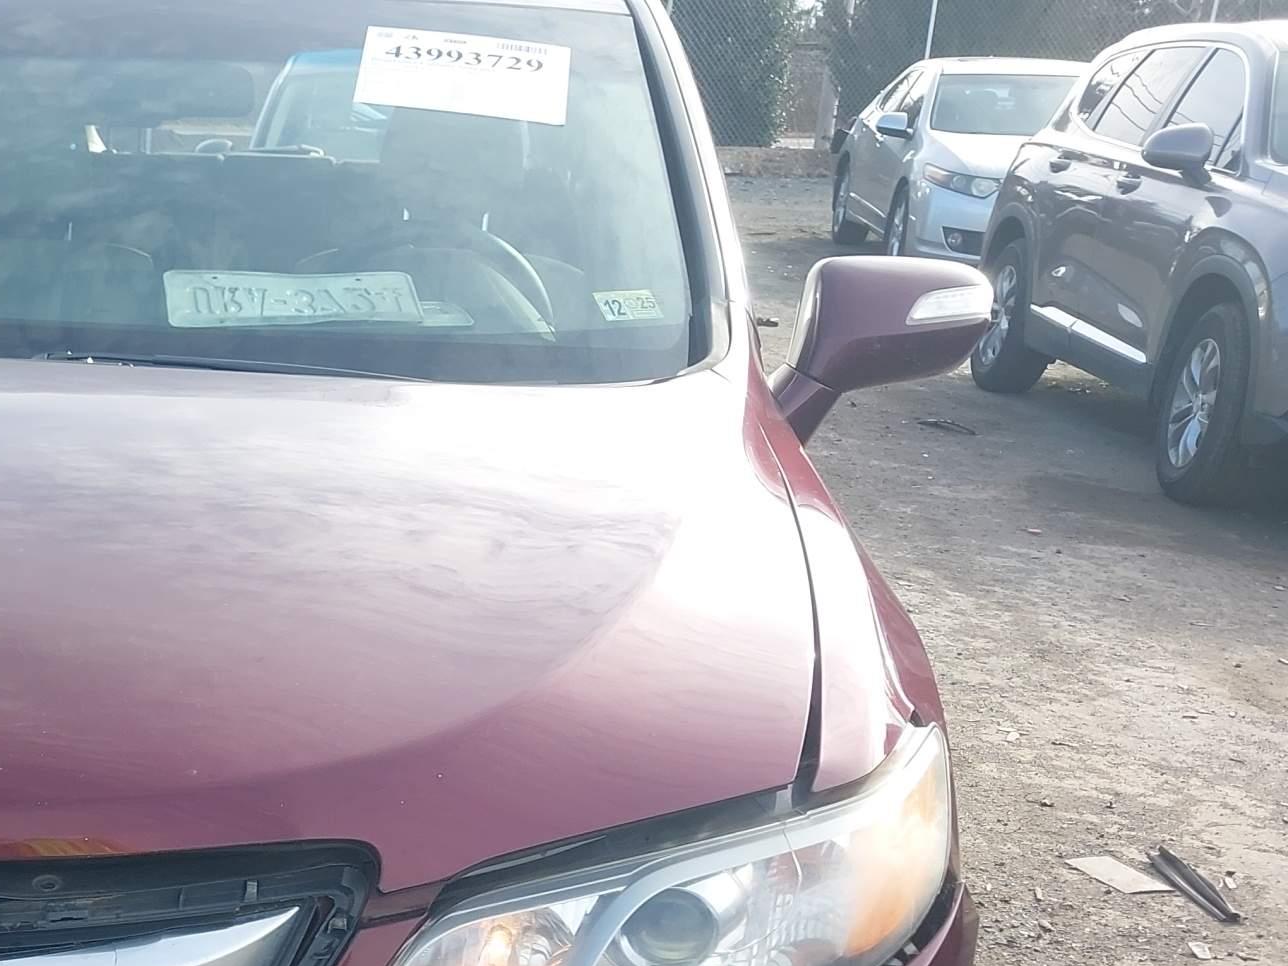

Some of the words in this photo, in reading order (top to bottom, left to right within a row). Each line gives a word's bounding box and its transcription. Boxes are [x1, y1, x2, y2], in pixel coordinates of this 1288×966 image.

[384, 44, 544, 73] 43993729
[603, 298, 628, 317] 12
[635, 296, 657, 310] 25
